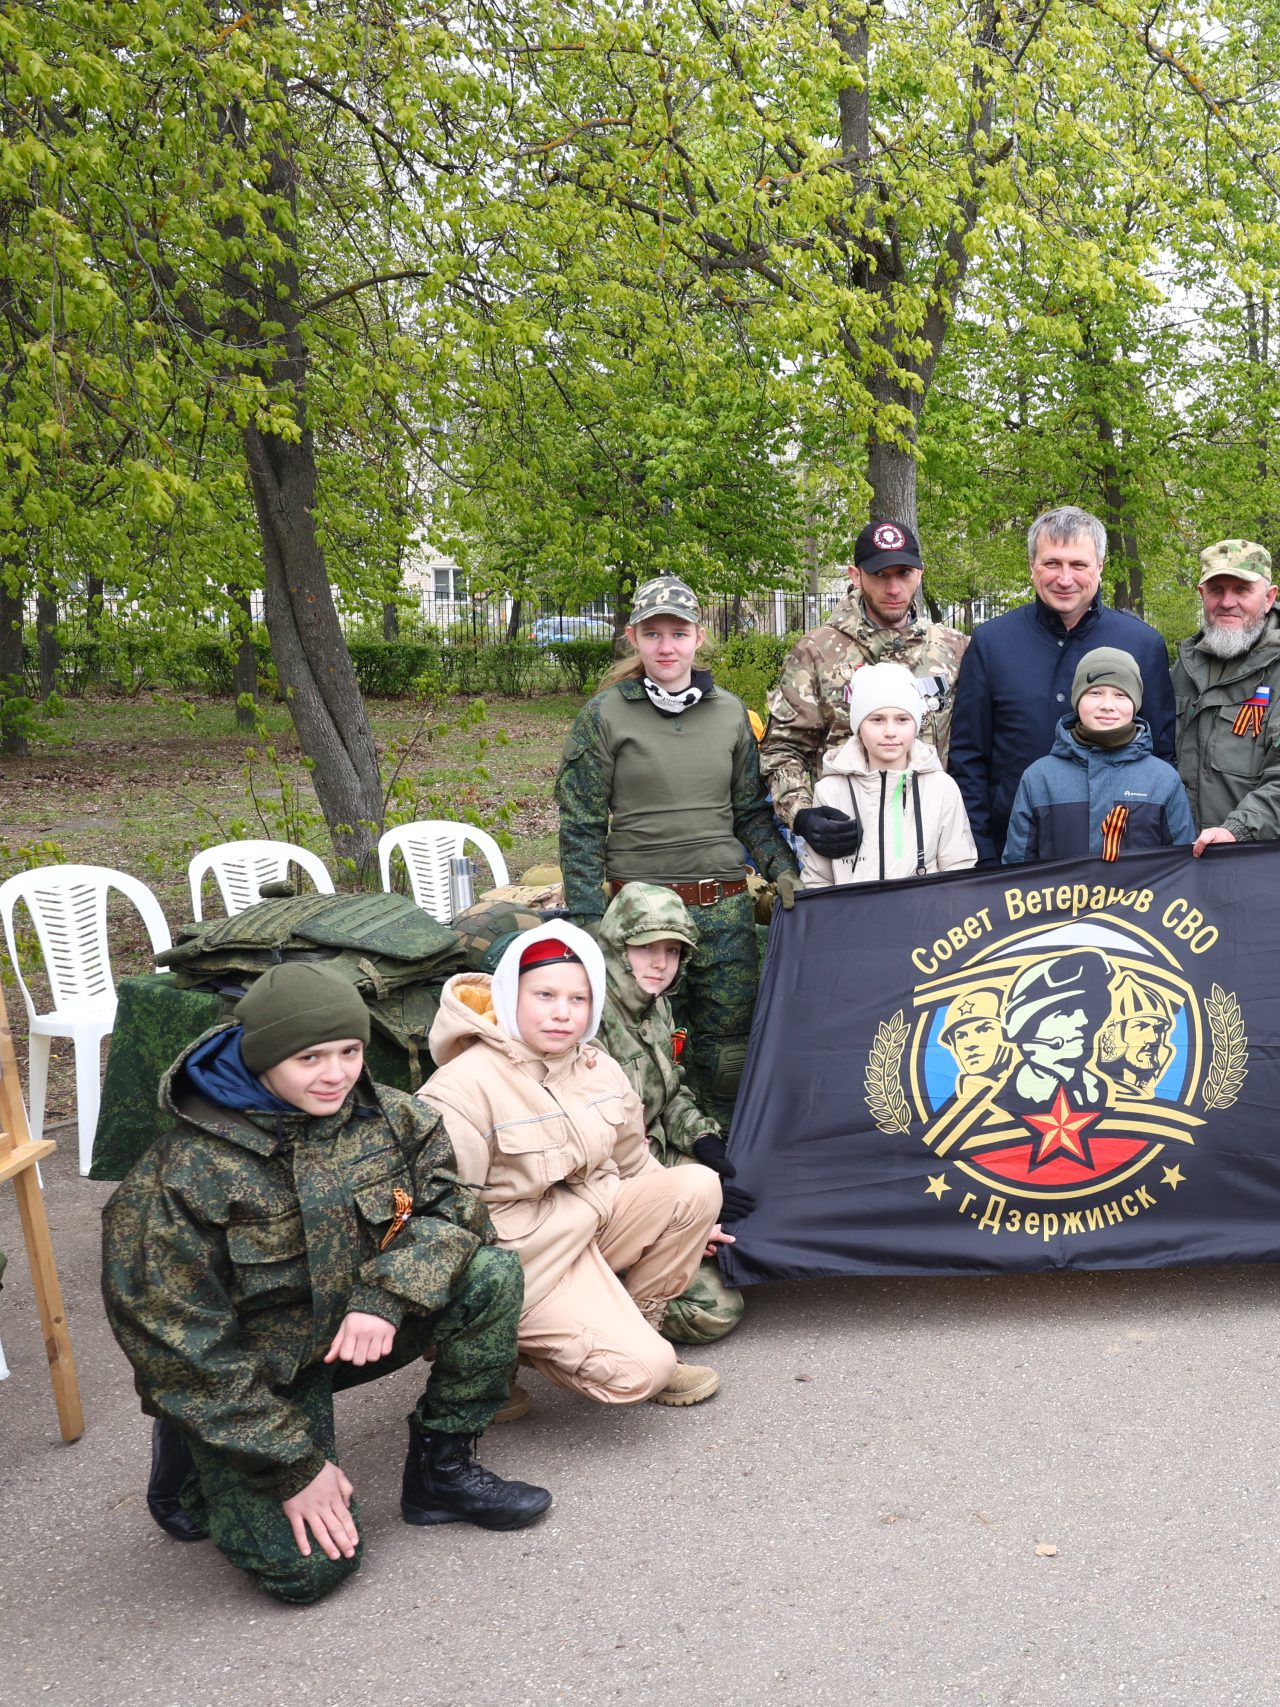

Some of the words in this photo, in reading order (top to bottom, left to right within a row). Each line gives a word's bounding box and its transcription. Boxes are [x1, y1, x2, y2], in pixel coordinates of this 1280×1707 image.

[911, 907, 994, 975] Совет
[1004, 883, 1155, 921] Ветеранов
[1161, 897, 1220, 955] СВО
[958, 1183, 1158, 1242] г.Дзержинск
